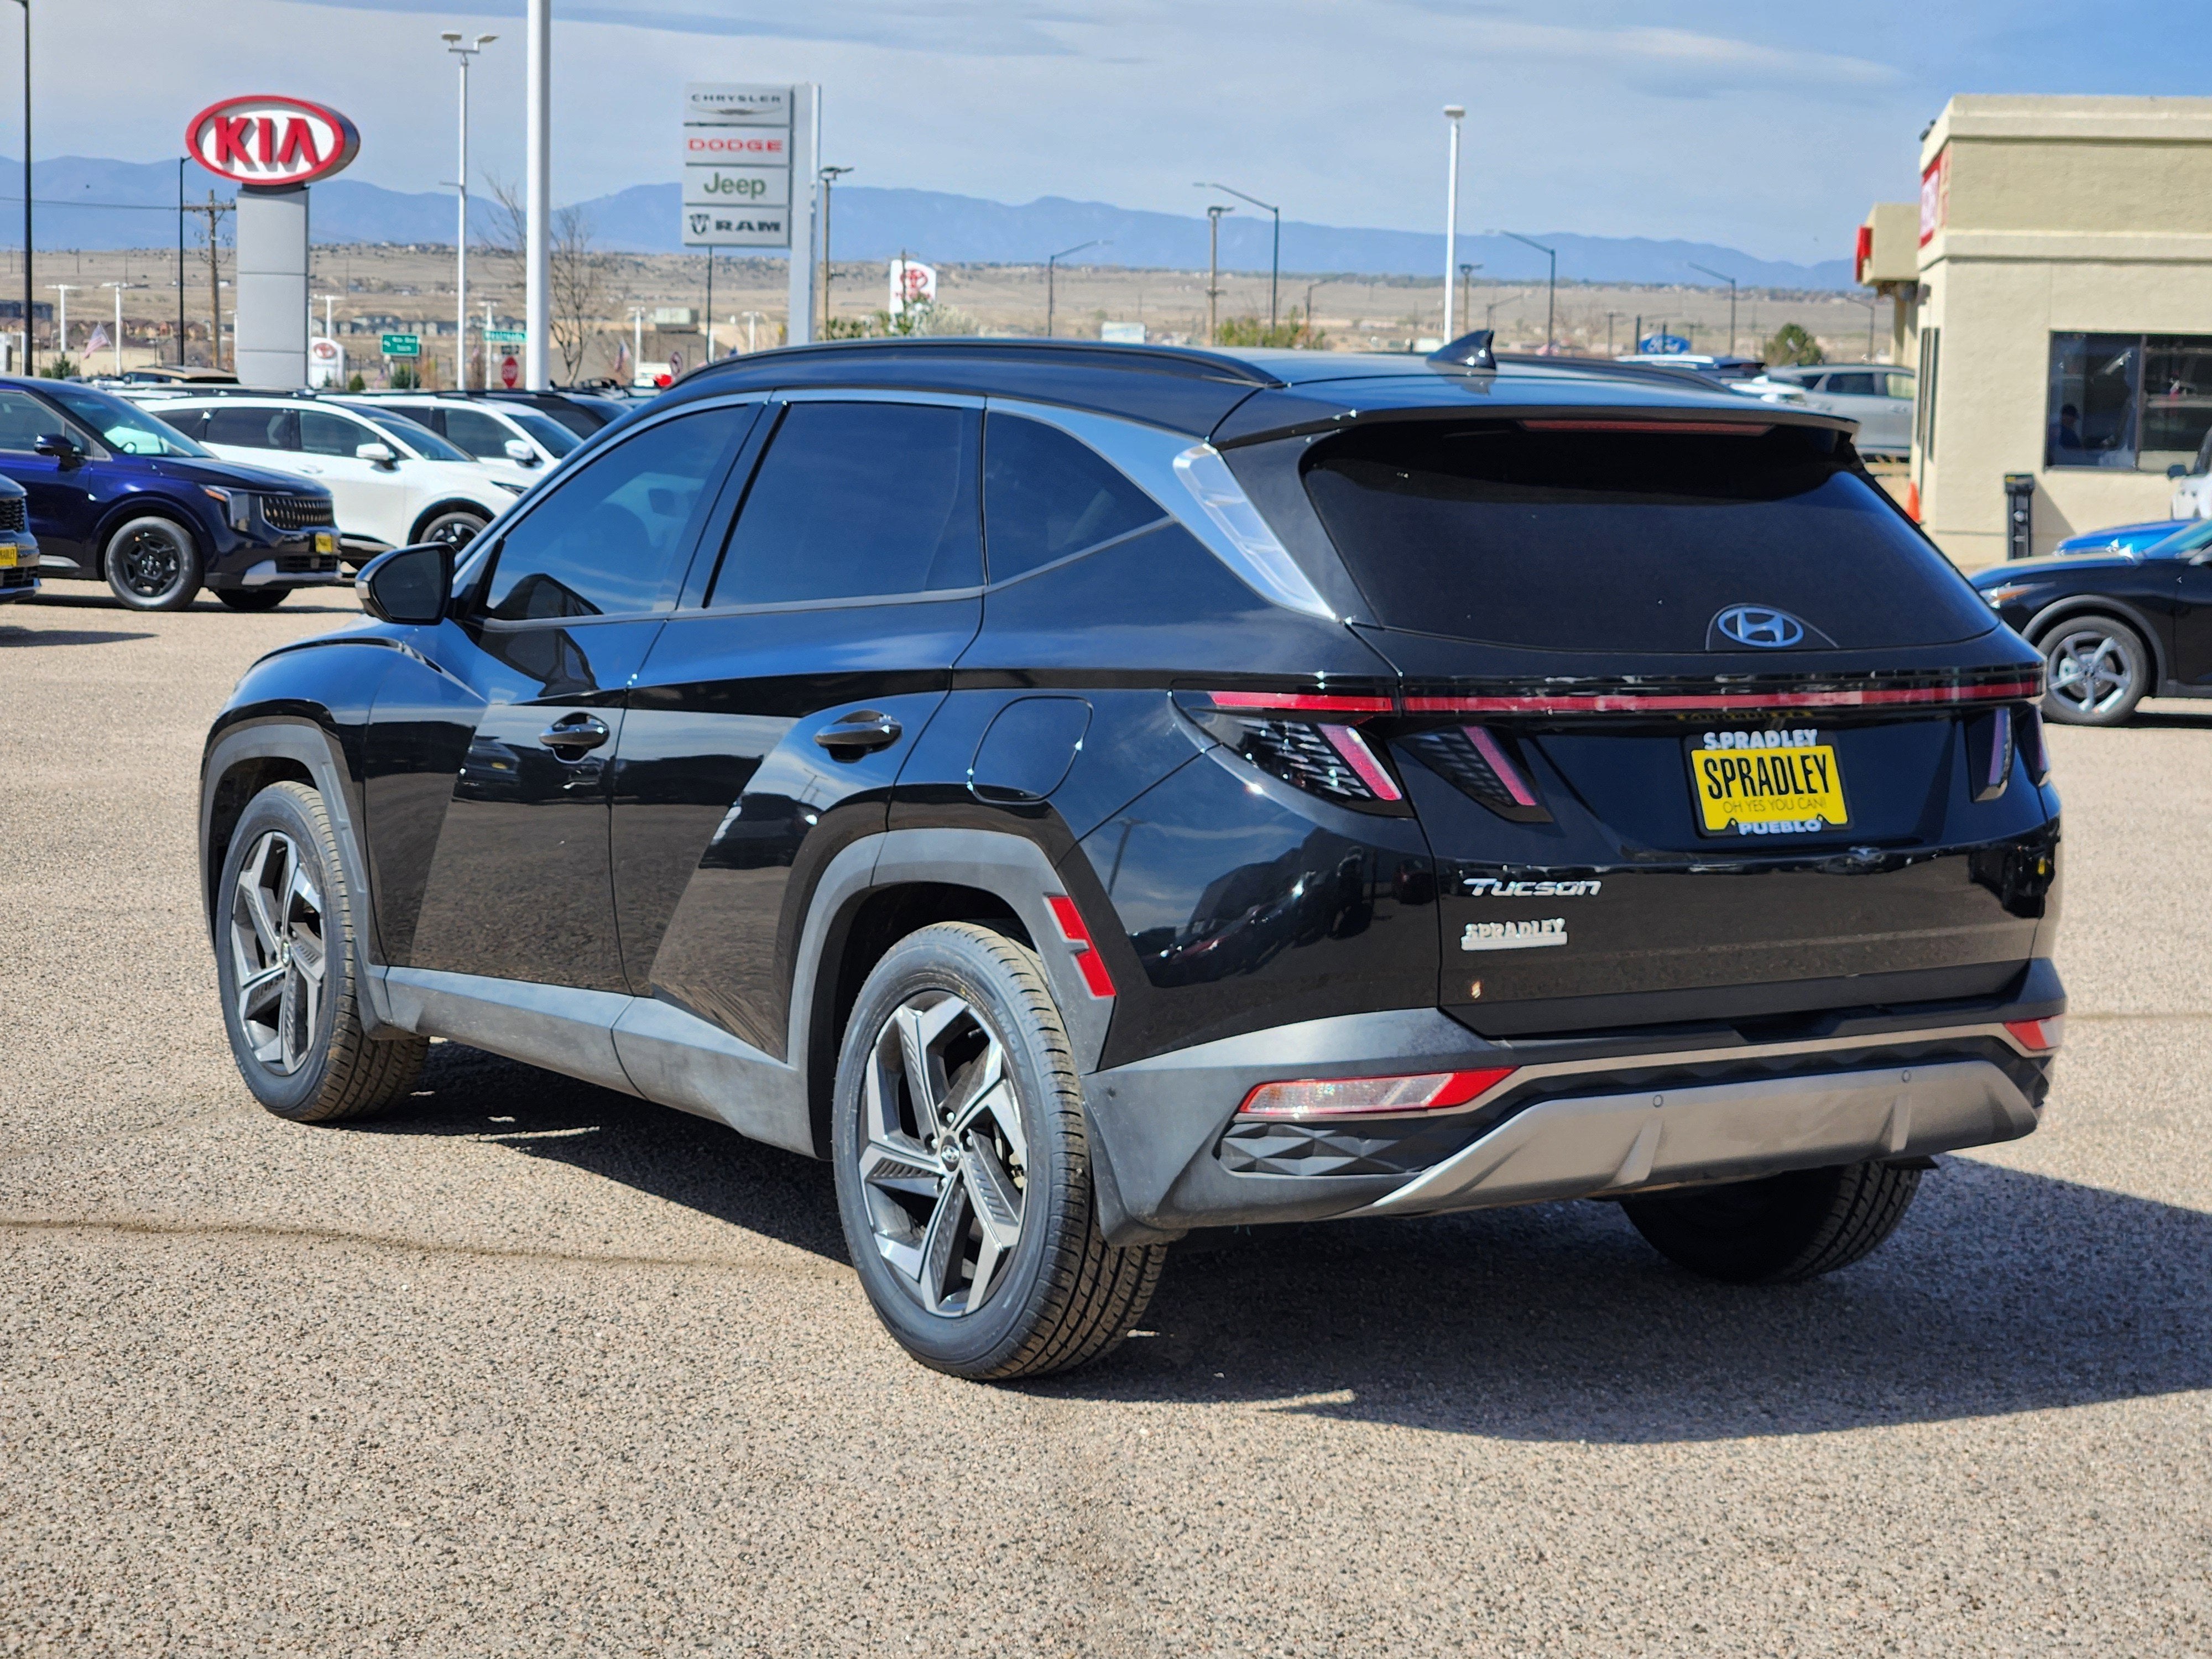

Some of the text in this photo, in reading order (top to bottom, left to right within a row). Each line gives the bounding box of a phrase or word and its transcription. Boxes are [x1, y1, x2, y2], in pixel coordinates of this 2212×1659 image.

[691, 93, 781, 103] CHRYSLER
[213, 116, 321, 165] KIA
[688, 139, 783, 153] DODGE
[703, 172, 767, 200] Jeep
[715, 220, 781, 232] RAM
[1703, 729, 1818, 750] SPRADLEY
[1704, 754, 1830, 800] SPRADLEY
[1723, 801, 1743, 813] OH
[1746, 800, 1766, 812] YES
[1769, 799, 1794, 811] YOU
[1738, 820, 1822, 836] PUEBLO
[1465, 917, 1566, 940] SPRADLEY
